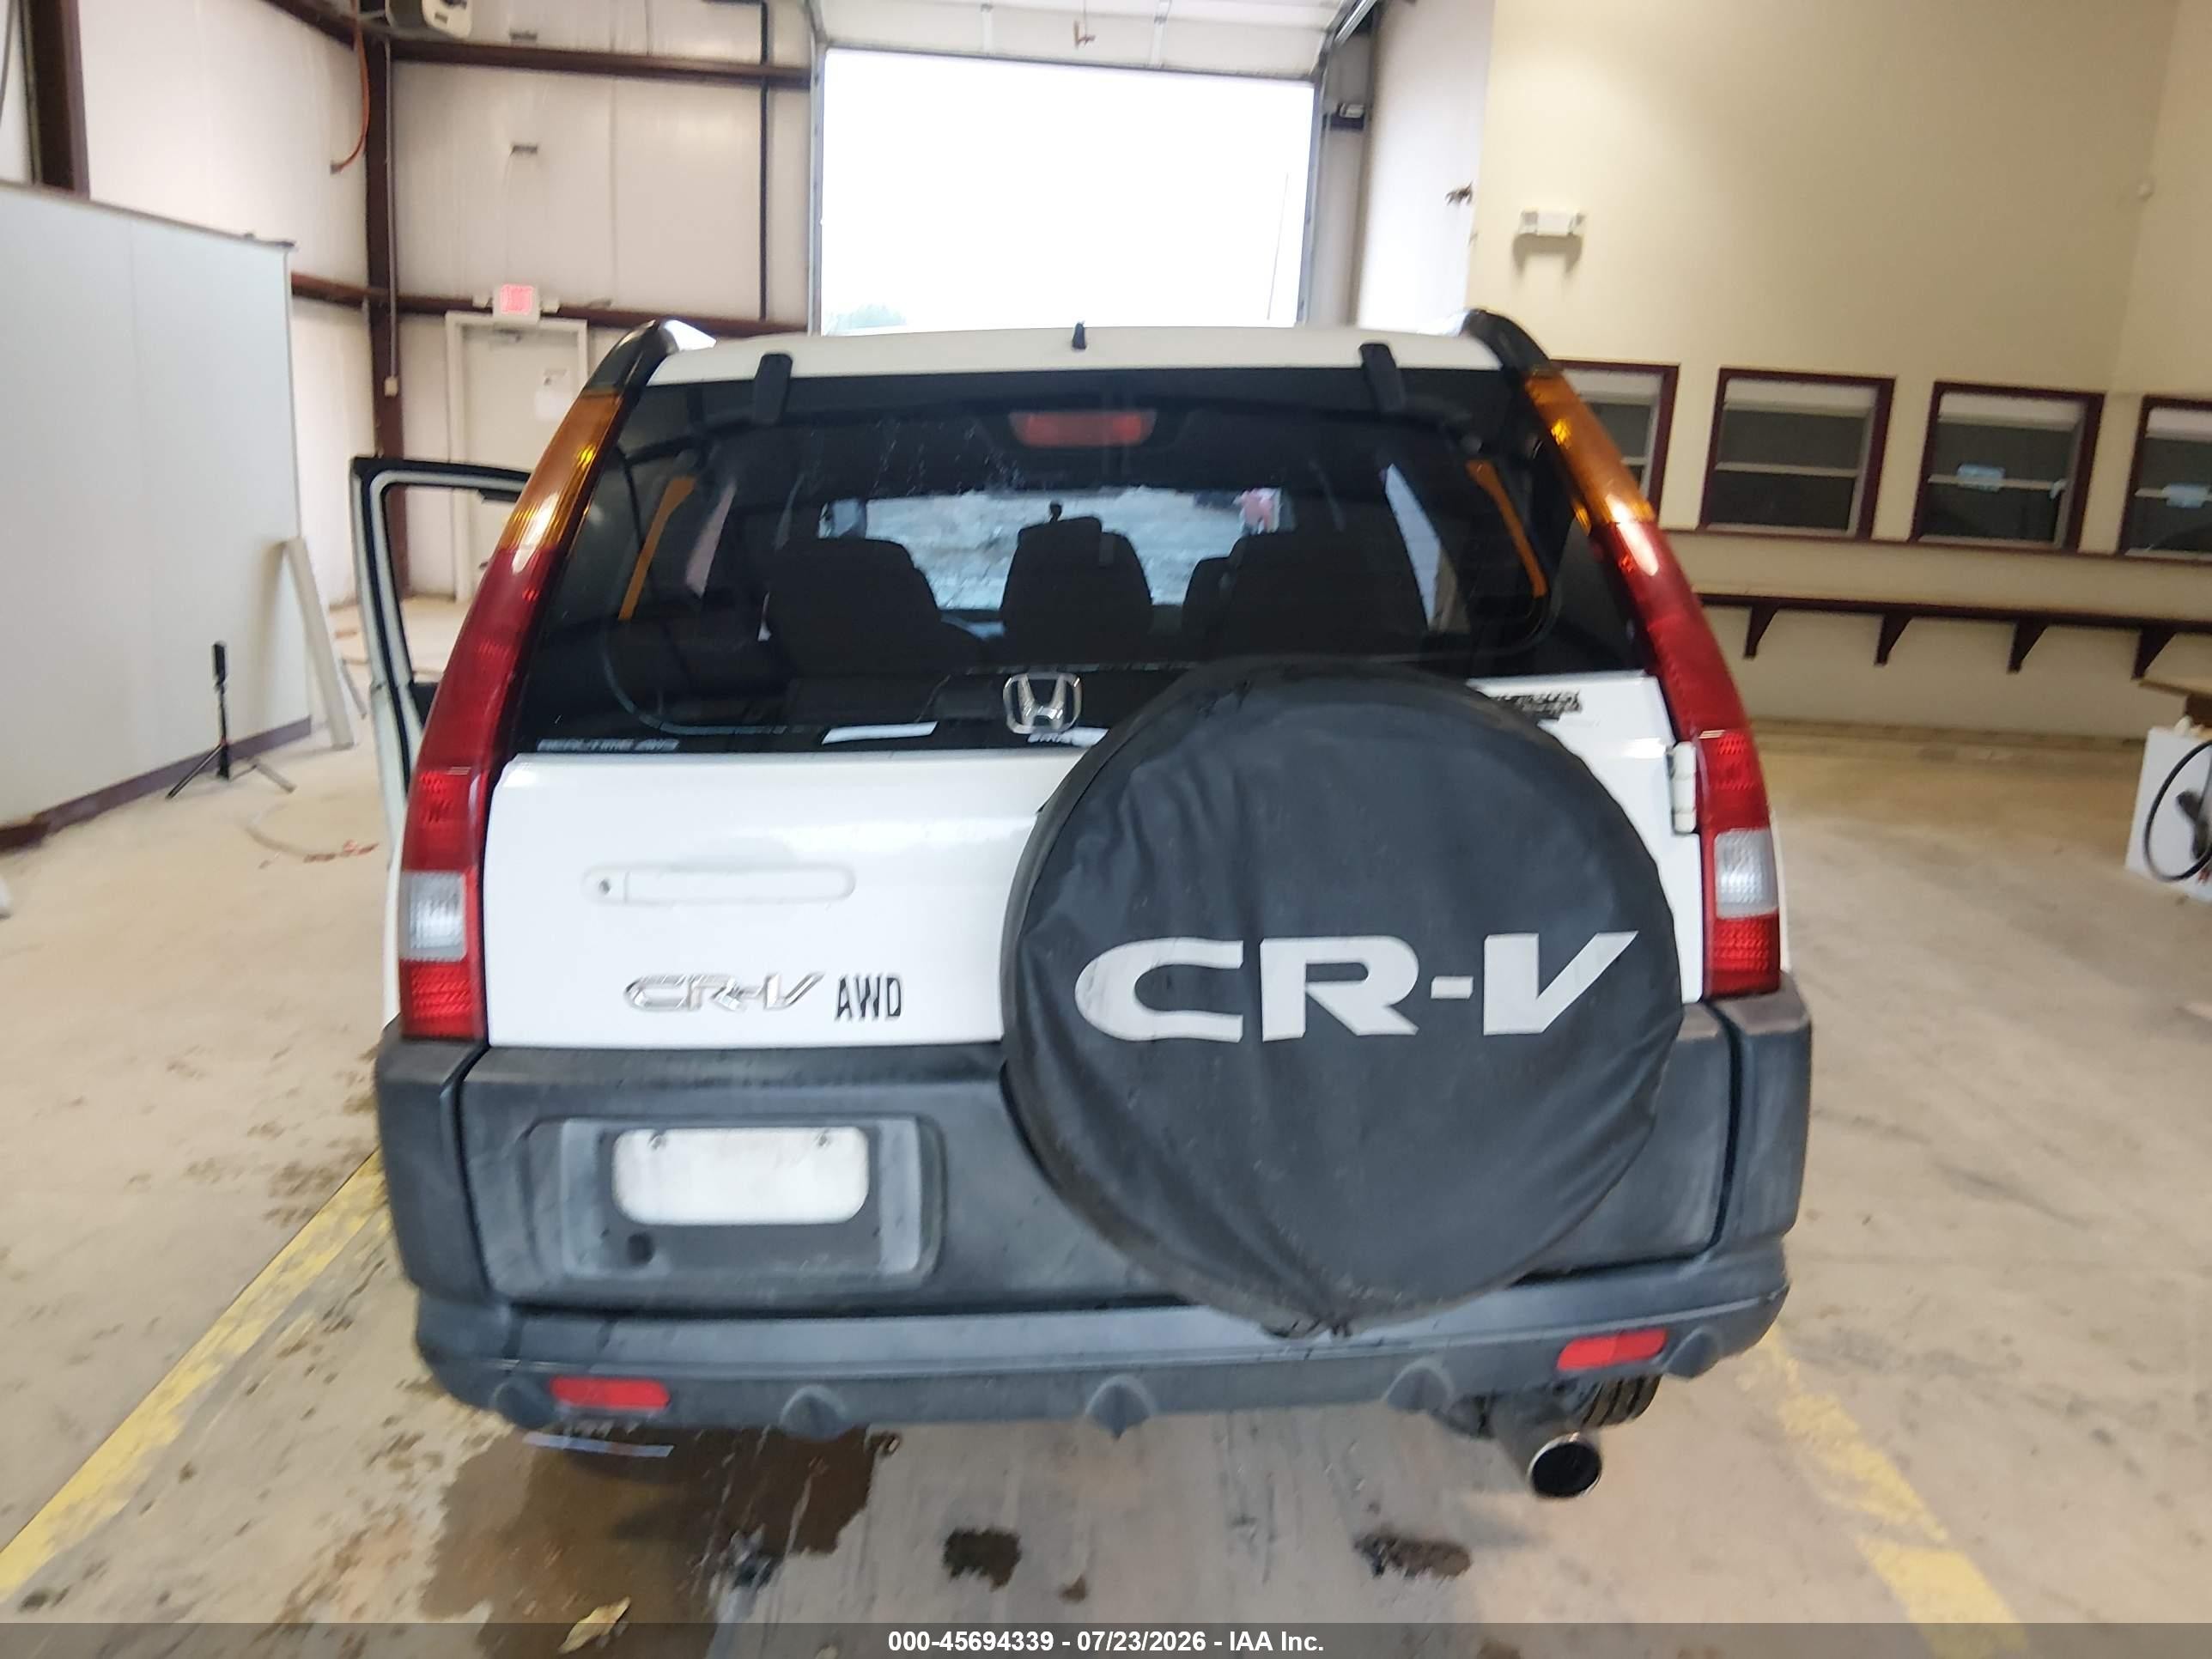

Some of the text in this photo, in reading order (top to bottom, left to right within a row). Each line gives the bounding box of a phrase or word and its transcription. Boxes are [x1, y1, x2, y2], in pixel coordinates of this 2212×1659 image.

[623, 971, 902, 1020] CR-V AWD
[1074, 930, 1638, 1042] CR-V
